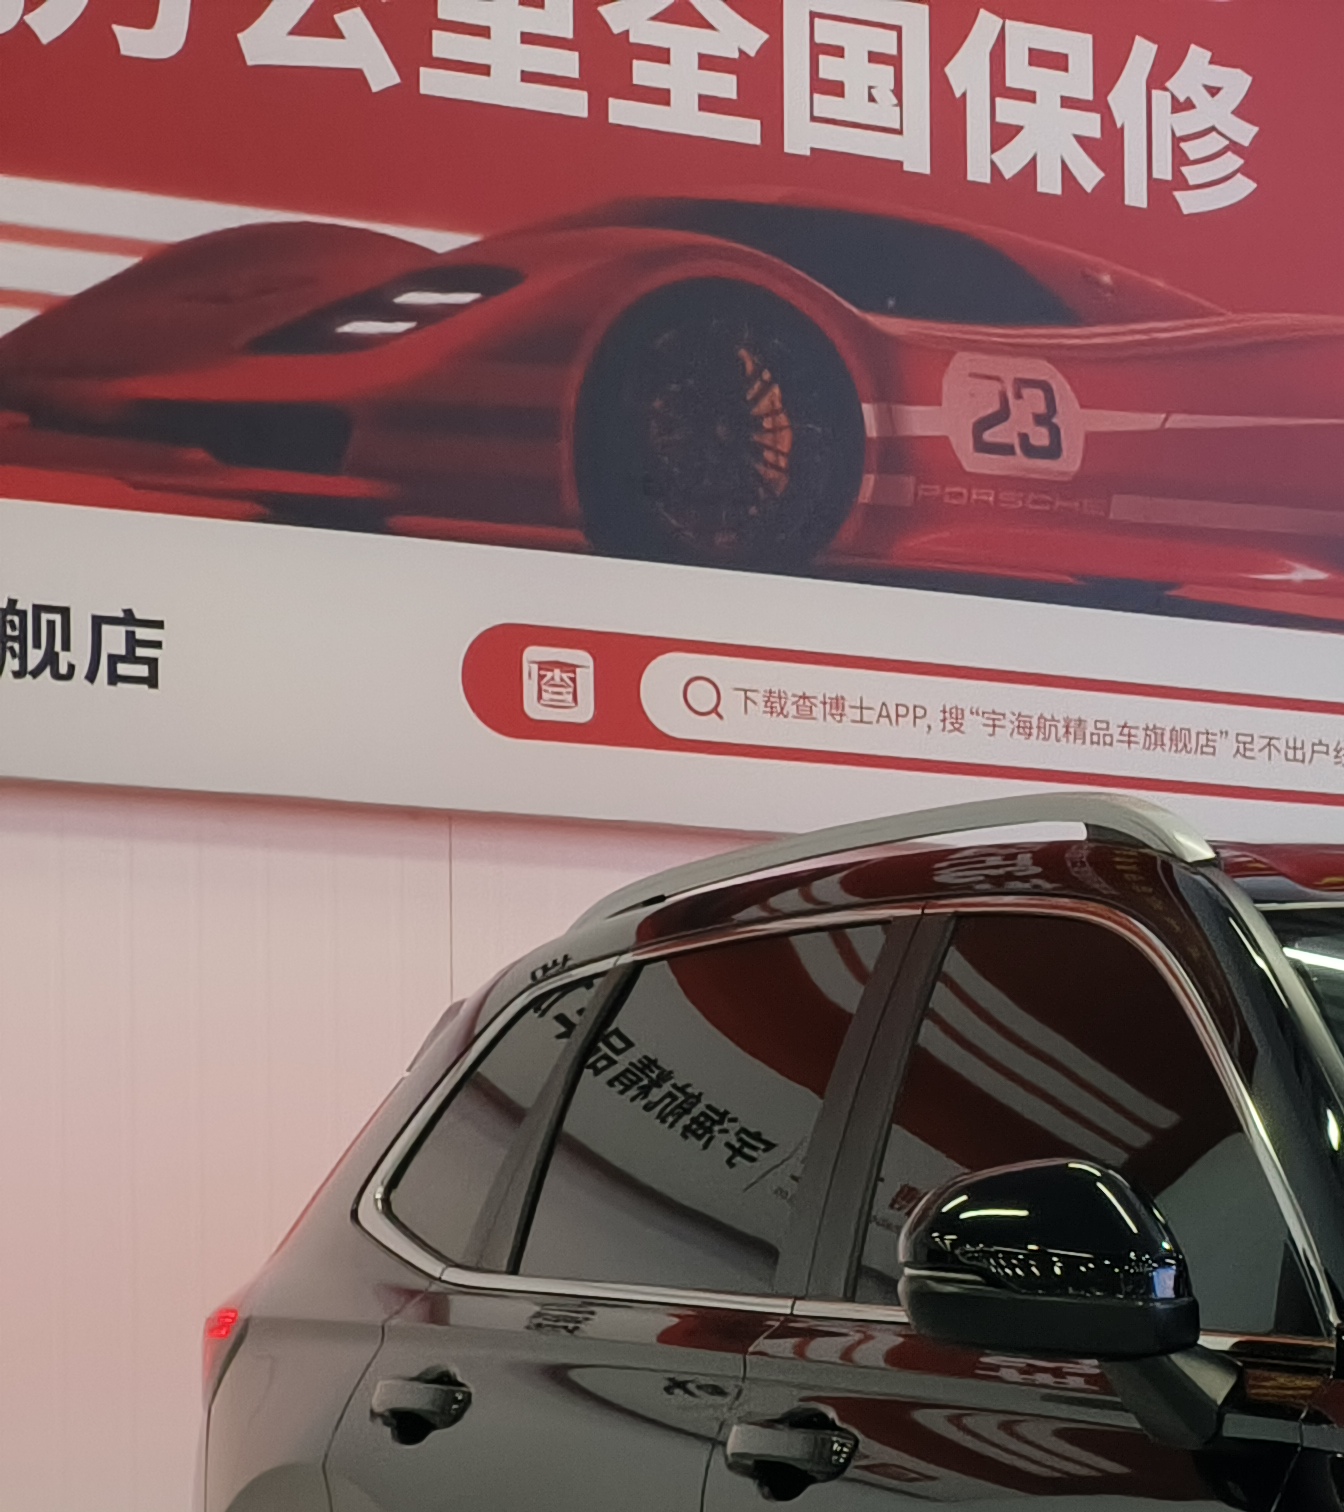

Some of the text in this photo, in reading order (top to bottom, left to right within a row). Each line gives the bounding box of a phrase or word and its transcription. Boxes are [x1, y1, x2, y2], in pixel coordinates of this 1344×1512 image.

[0, 0, 1260, 215] 公里全国保修
[967, 371, 1064, 461] 23
